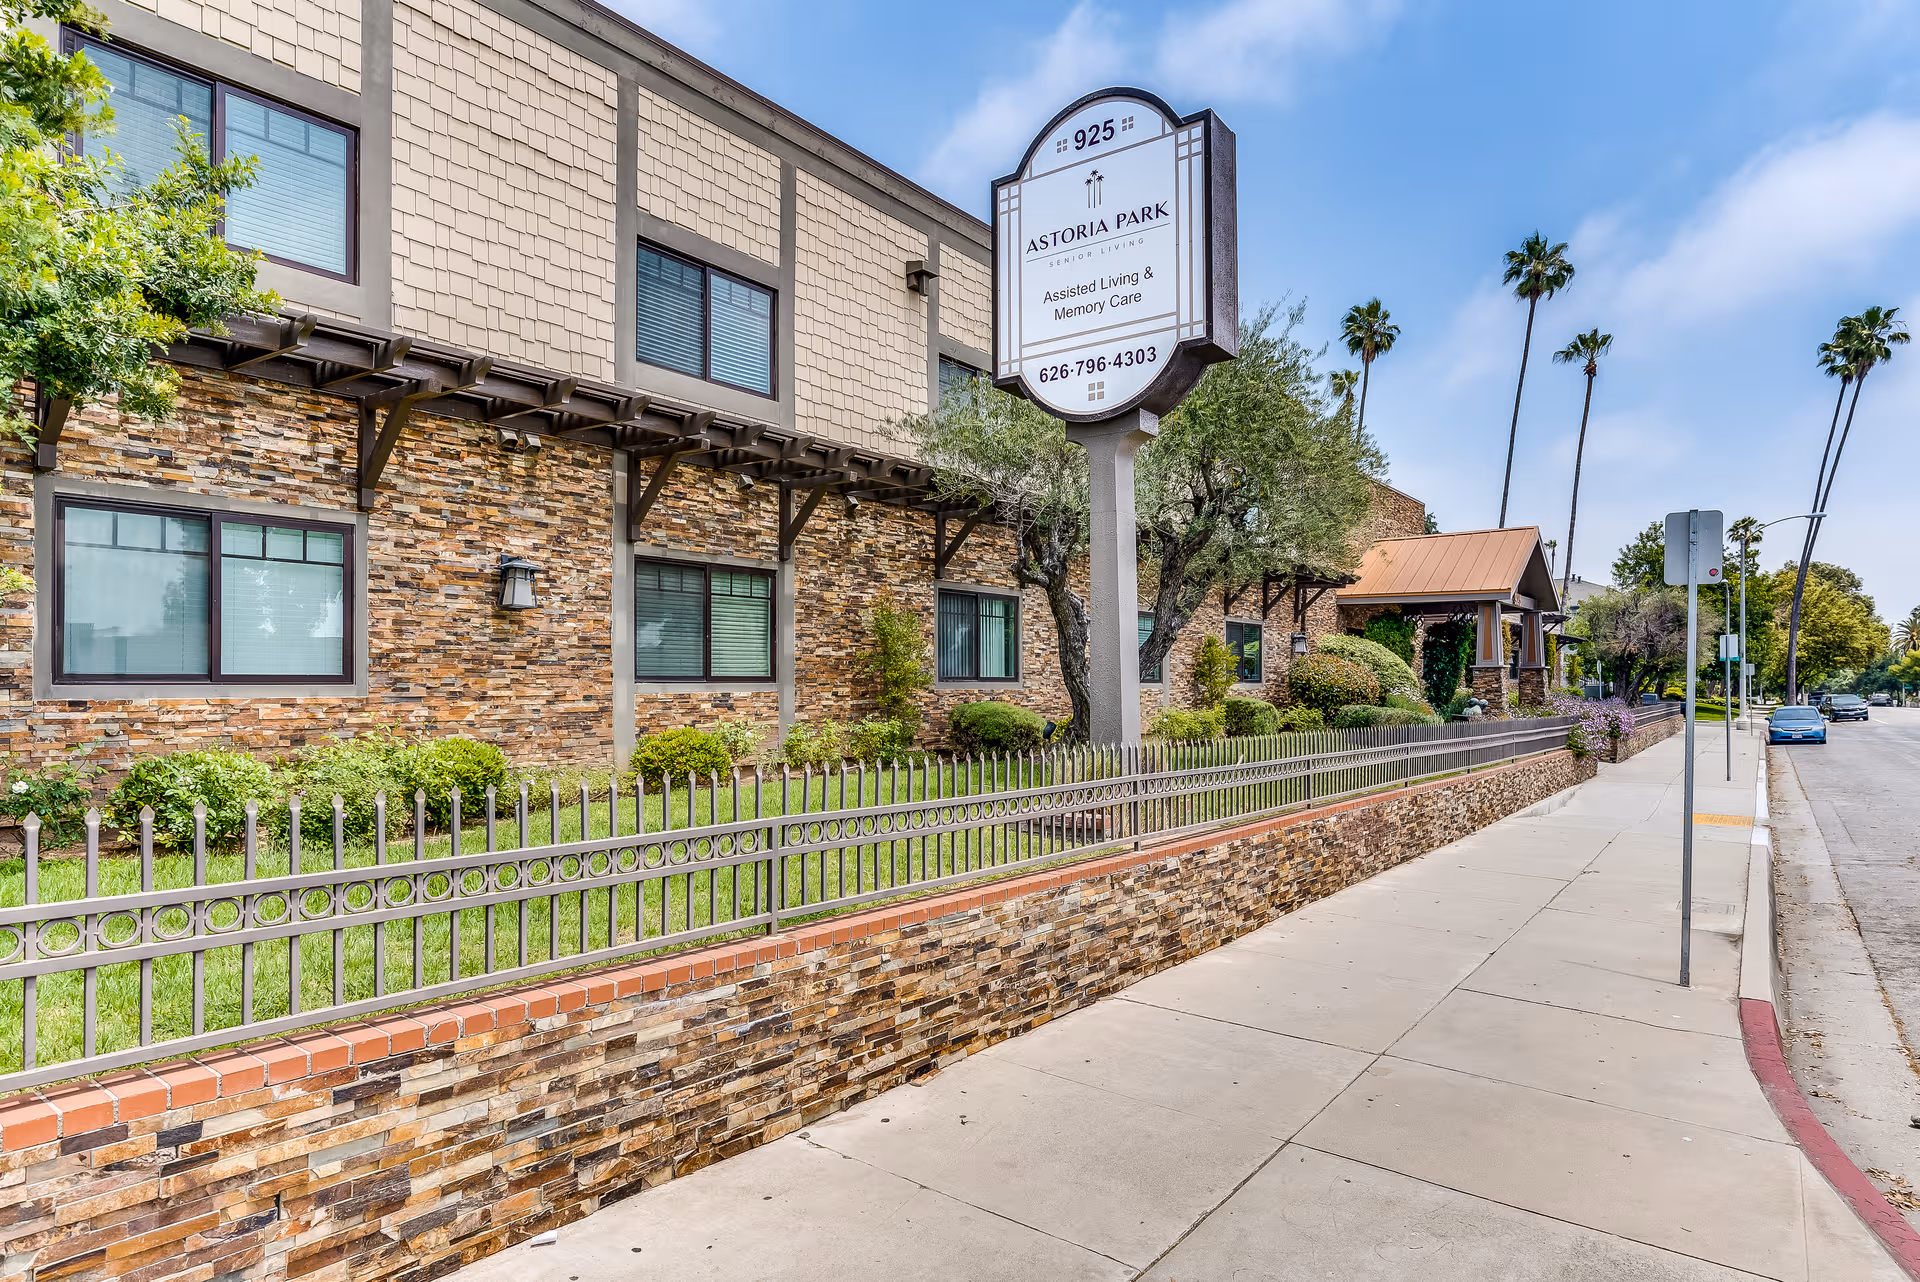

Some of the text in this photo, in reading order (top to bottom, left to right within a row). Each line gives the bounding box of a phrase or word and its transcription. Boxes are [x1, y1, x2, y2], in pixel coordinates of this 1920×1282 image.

[1074, 118, 1115, 151] 925
[1026, 200, 1169, 254] ASTORIA PARK
[1049, 238, 1144, 267] SENIOR LIVING
[1043, 266, 1154, 304] Assisted Living &
[1054, 292, 1142, 321] Memory Care
